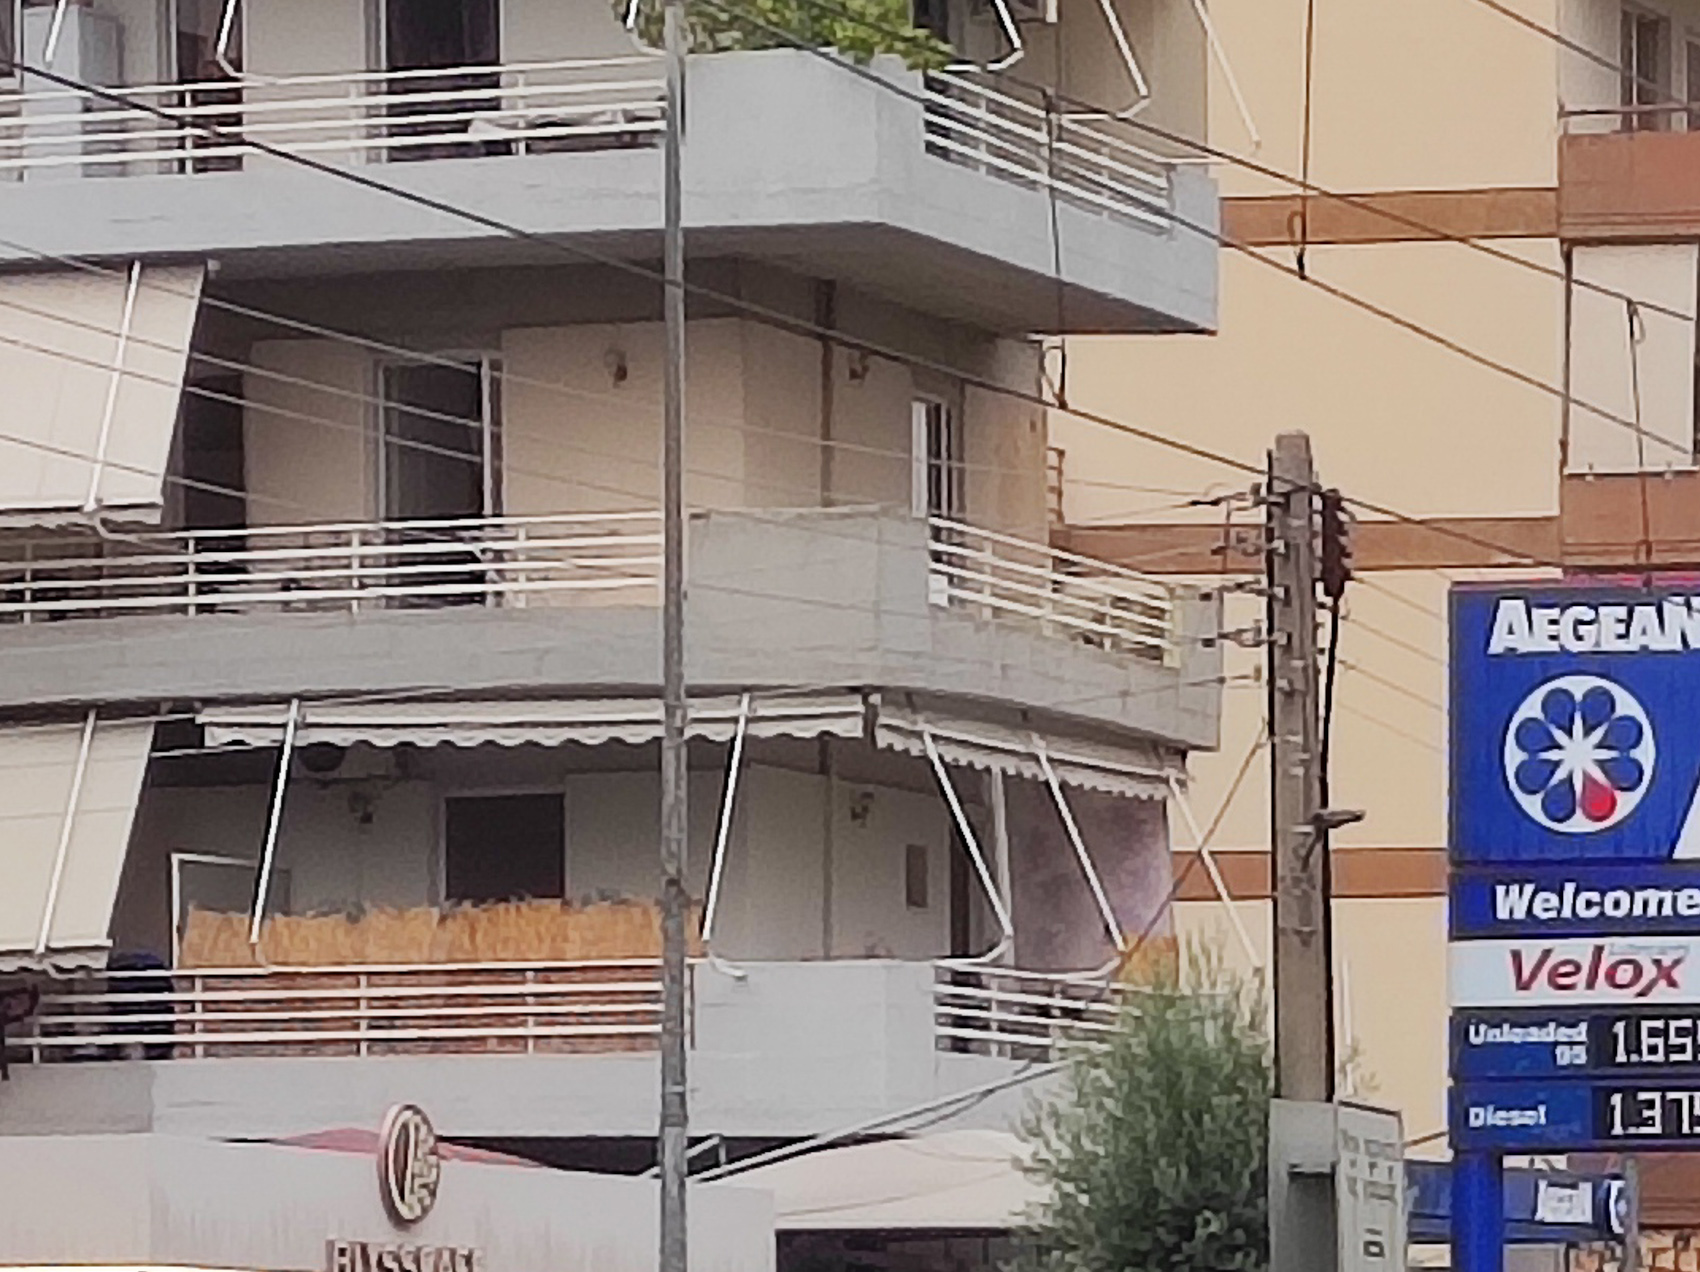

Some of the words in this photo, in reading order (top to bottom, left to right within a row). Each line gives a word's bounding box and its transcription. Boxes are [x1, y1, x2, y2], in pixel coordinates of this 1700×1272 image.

[1509, 944, 1686, 998] Velox
[1468, 1020, 1588, 1046] Unleaded
[1468, 1103, 1547, 1128] Diesel
